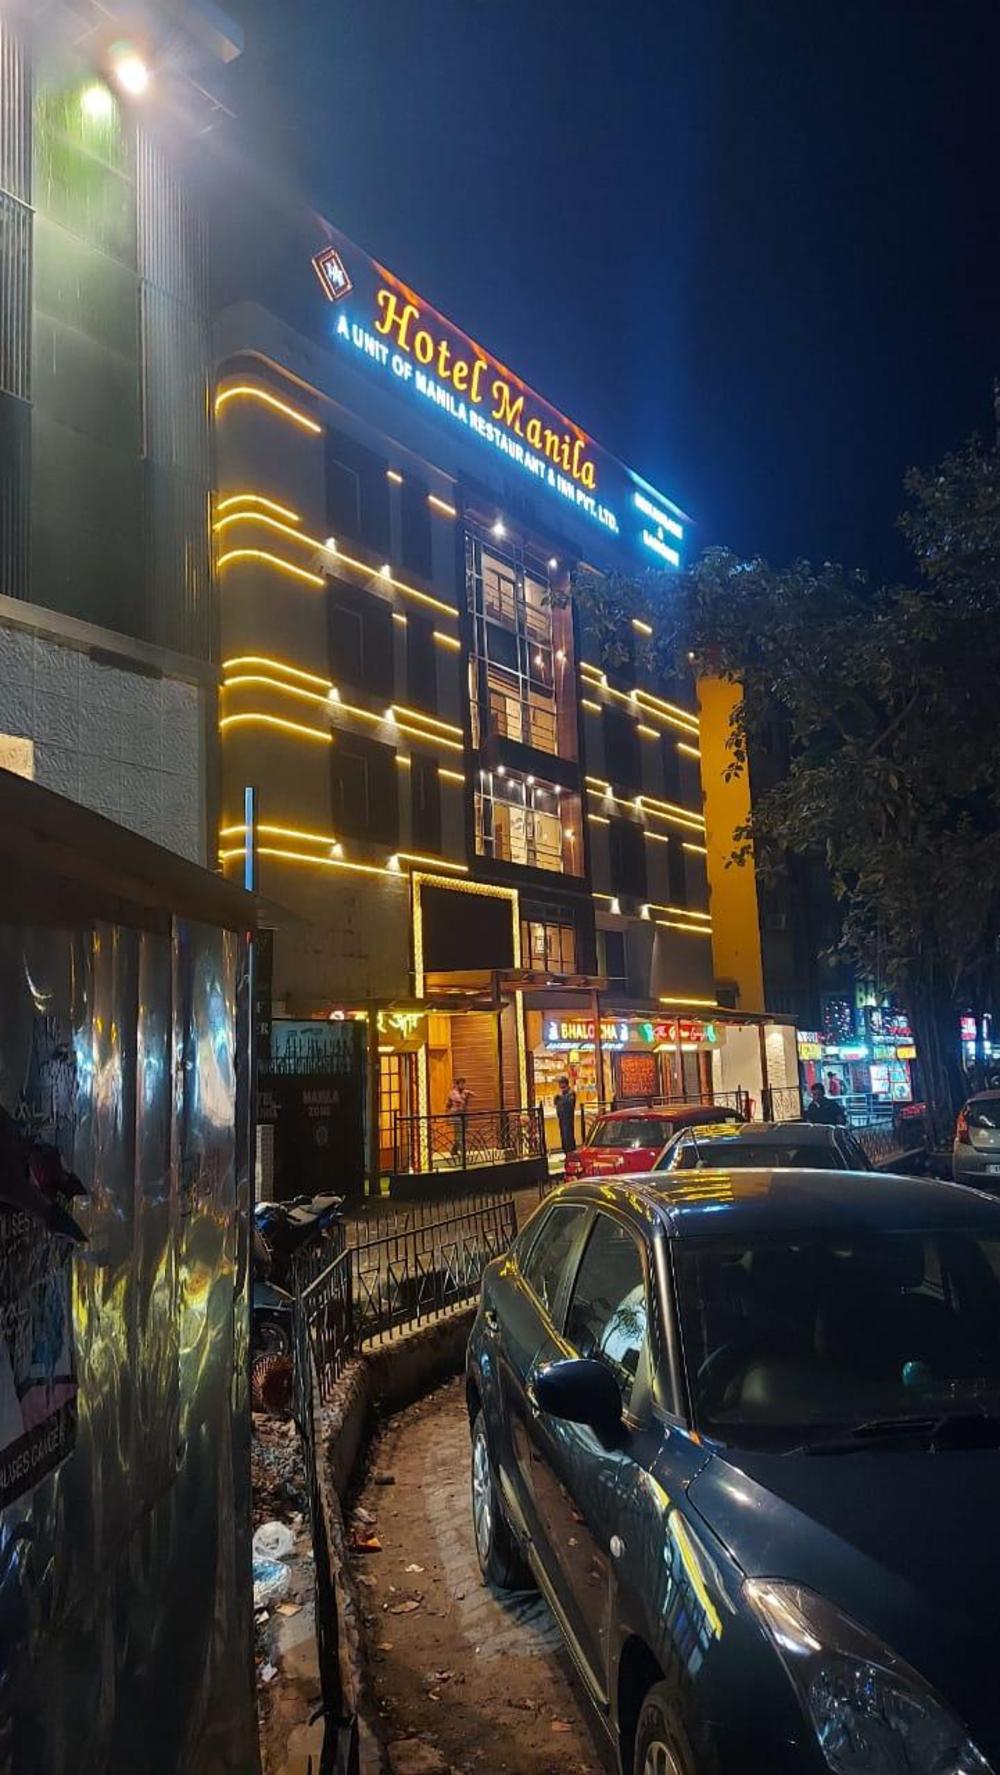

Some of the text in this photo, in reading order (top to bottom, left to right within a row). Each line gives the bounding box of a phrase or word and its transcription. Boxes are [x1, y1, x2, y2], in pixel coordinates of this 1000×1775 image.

[336, 315, 350, 341] A
[351, 323, 389, 366] UNIT
[391, 354, 413, 381] OF
[415, 370, 468, 425] MANILA
[469, 409, 546, 479] RESTAURANT
[547, 468, 557, 488] &
[557, 474, 575, 502] INN
[598, 504, 620, 534] LTD.
[374, 289, 597, 491] Hotel Manila
